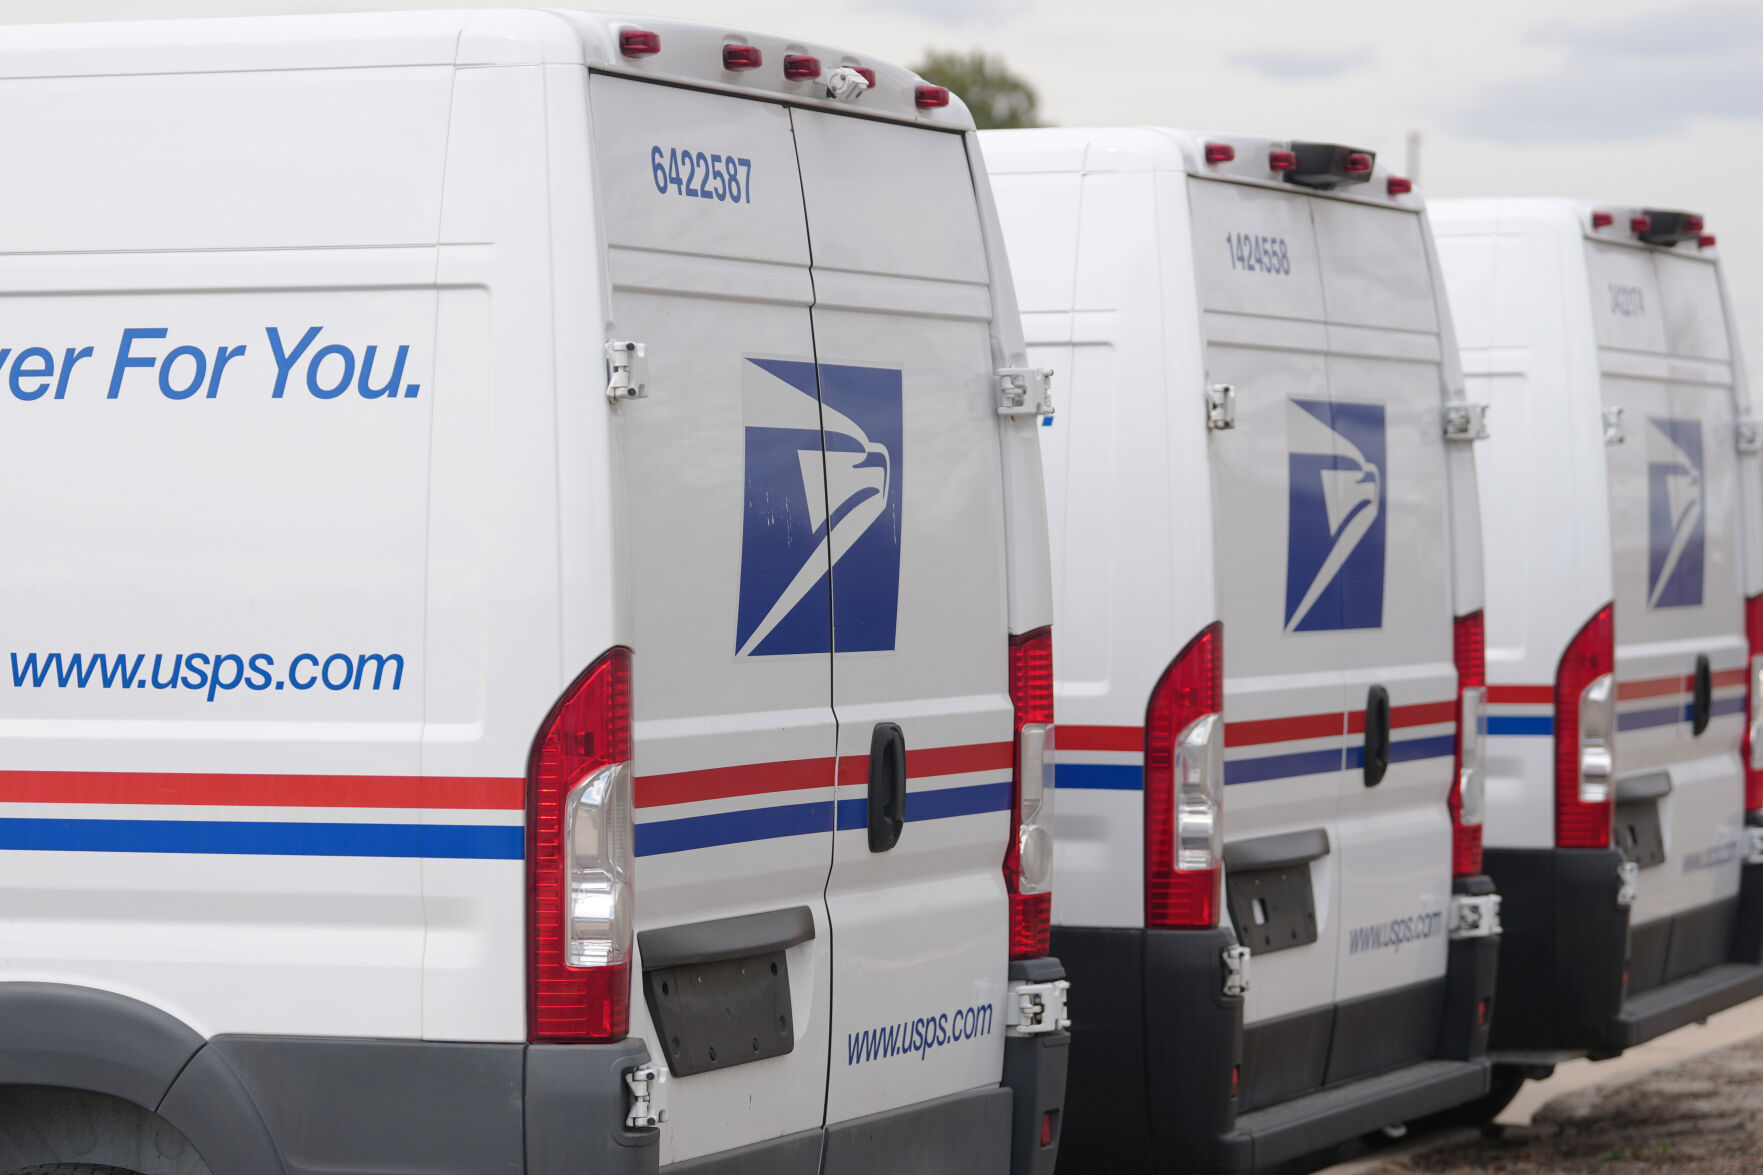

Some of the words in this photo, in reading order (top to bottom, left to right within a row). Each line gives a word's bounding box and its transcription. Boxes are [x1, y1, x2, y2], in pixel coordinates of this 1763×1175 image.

[650, 145, 752, 204] 6422587
[1226, 231, 1290, 276] 1424558
[107, 327, 247, 400] For
[266, 326, 420, 400] You.
[10, 652, 404, 703] www.usps.com
[848, 1004, 993, 1065] www.usps.com
